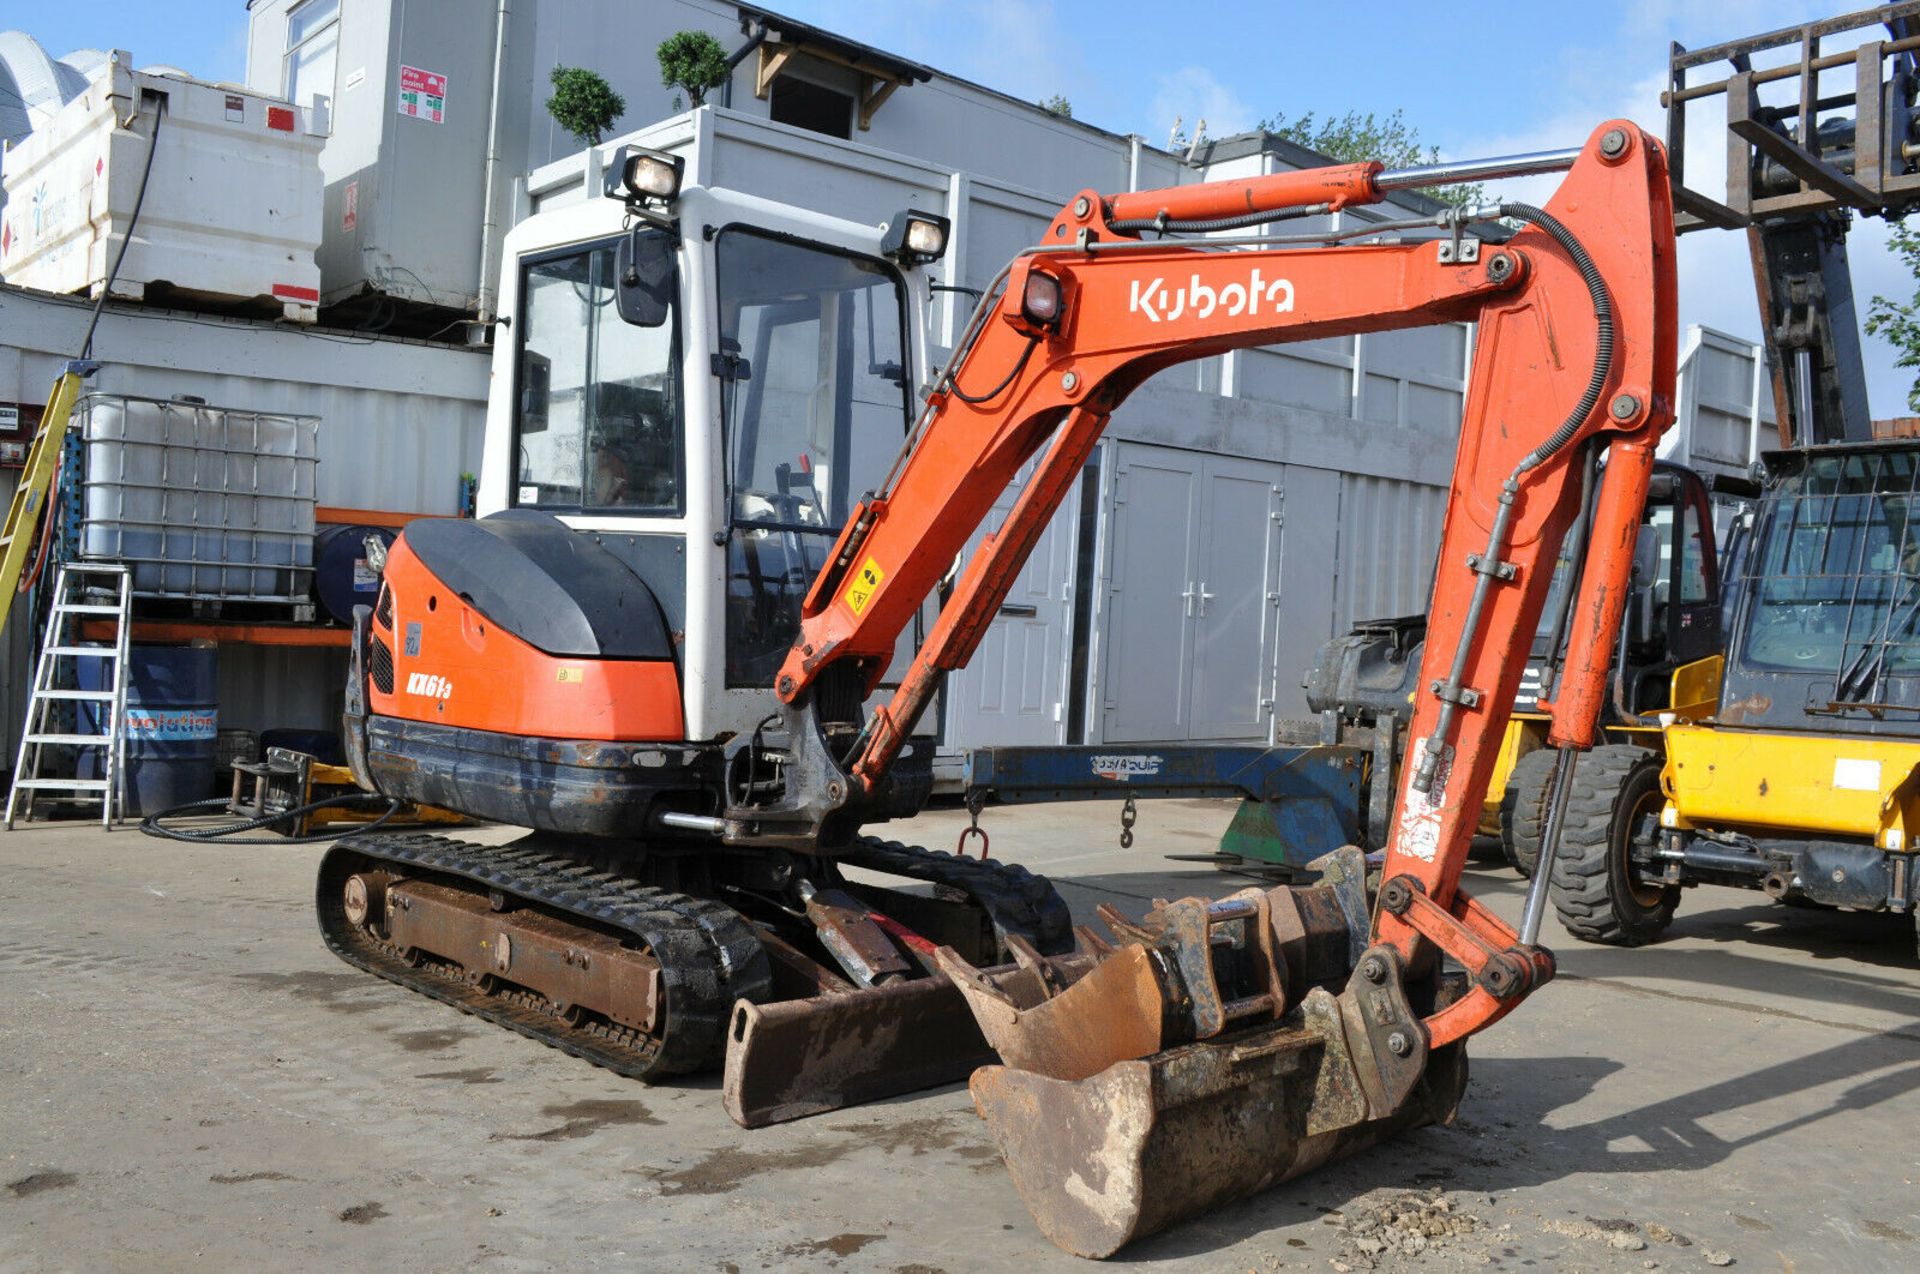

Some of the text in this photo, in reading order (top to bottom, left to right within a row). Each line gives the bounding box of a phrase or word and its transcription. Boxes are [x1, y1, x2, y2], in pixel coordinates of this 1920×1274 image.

[403, 69, 420, 79] Fire
[403, 80, 425, 90] point
[1130, 268, 1295, 322] Kubota
